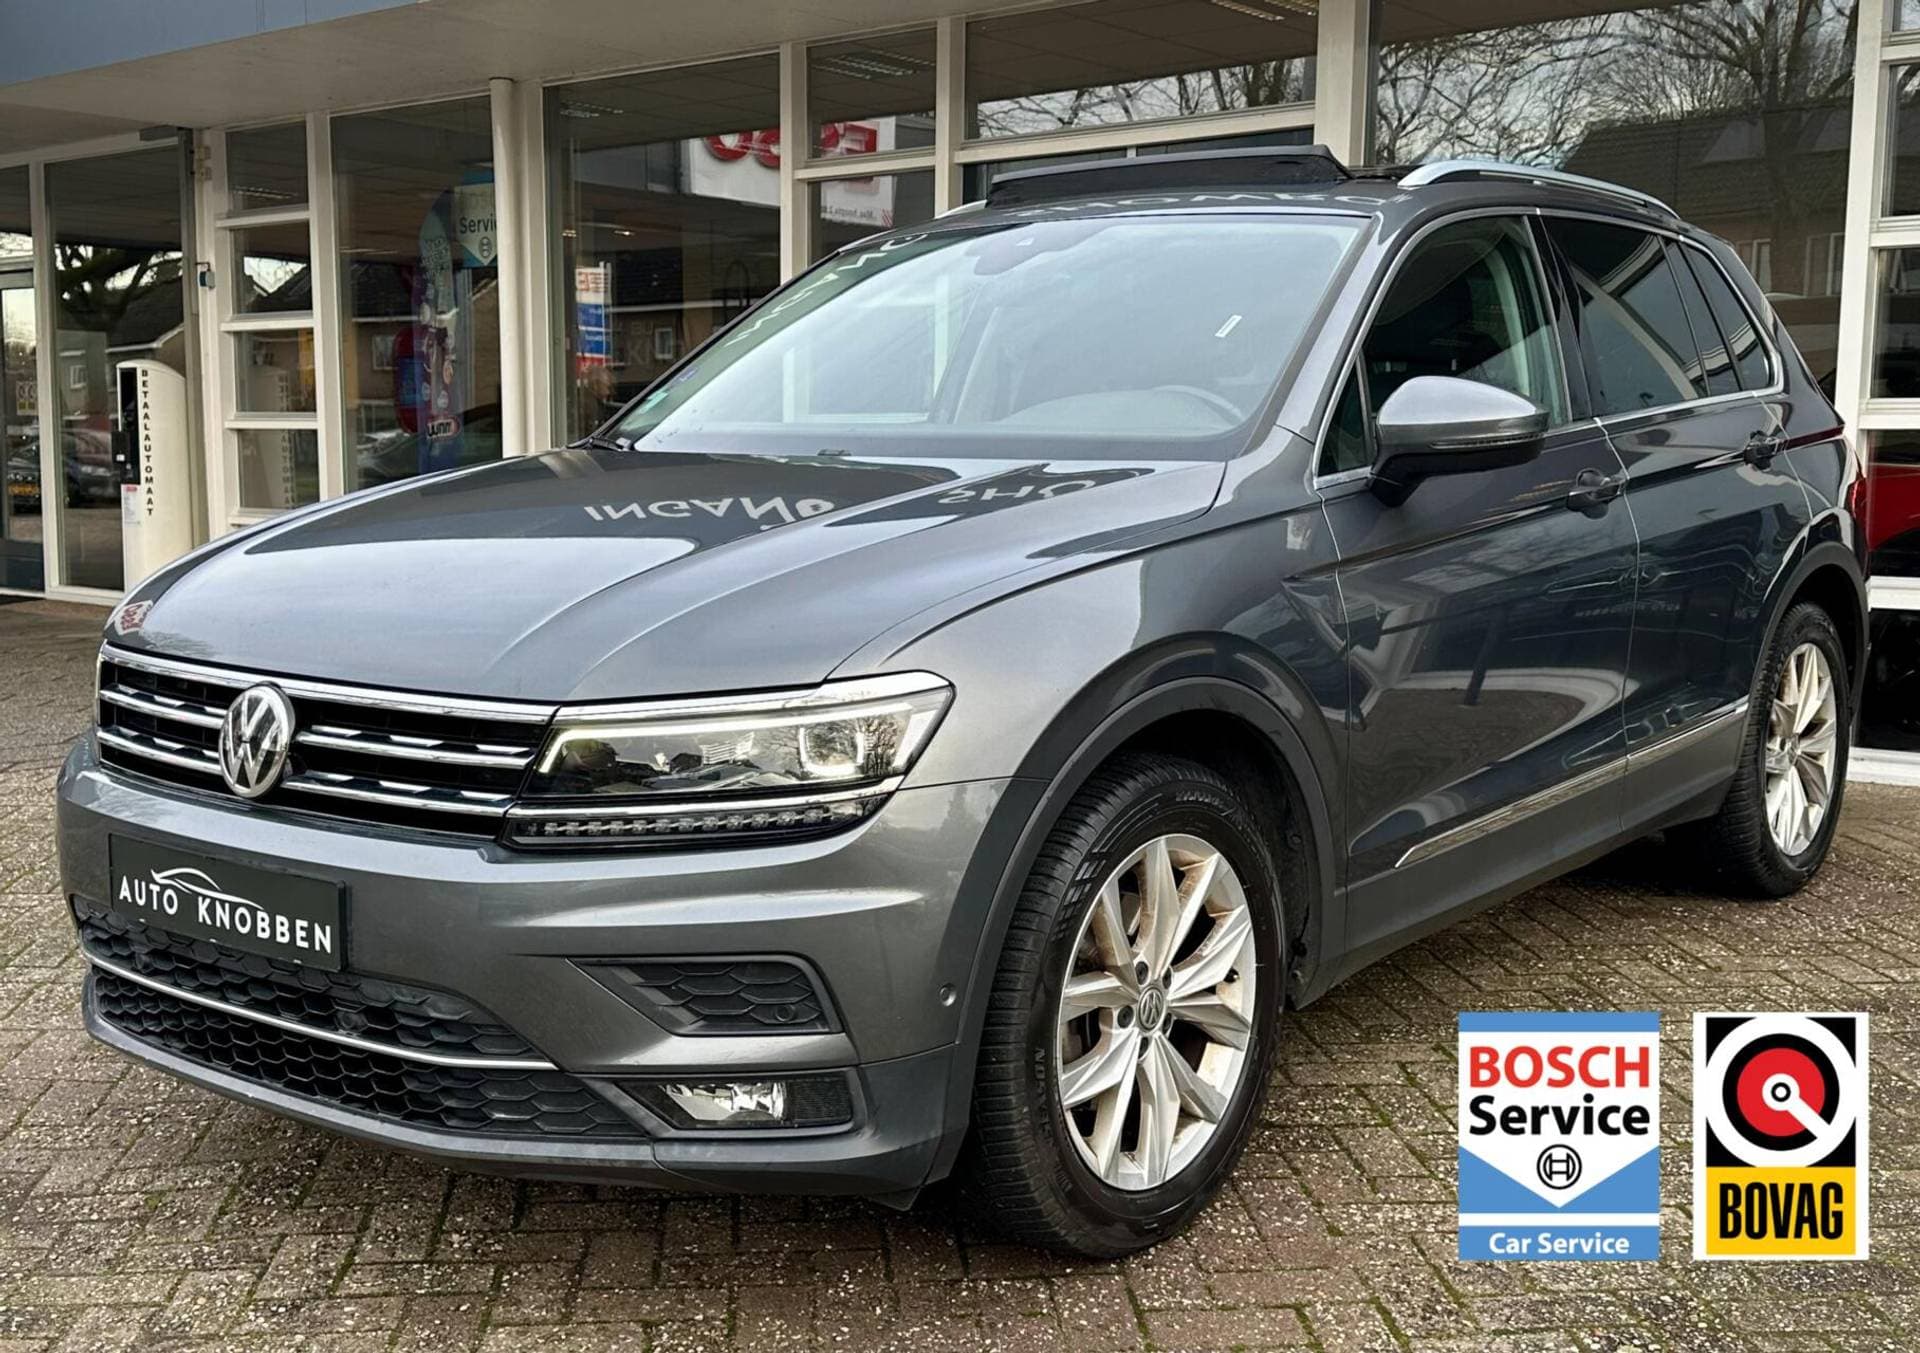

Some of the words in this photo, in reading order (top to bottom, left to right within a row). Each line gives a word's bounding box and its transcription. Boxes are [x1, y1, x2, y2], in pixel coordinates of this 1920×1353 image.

[141, 369, 154, 517] BETAALAUTOMAAT
[119, 875, 179, 916] AUTO
[197, 895, 333, 954] KNOBBEN
